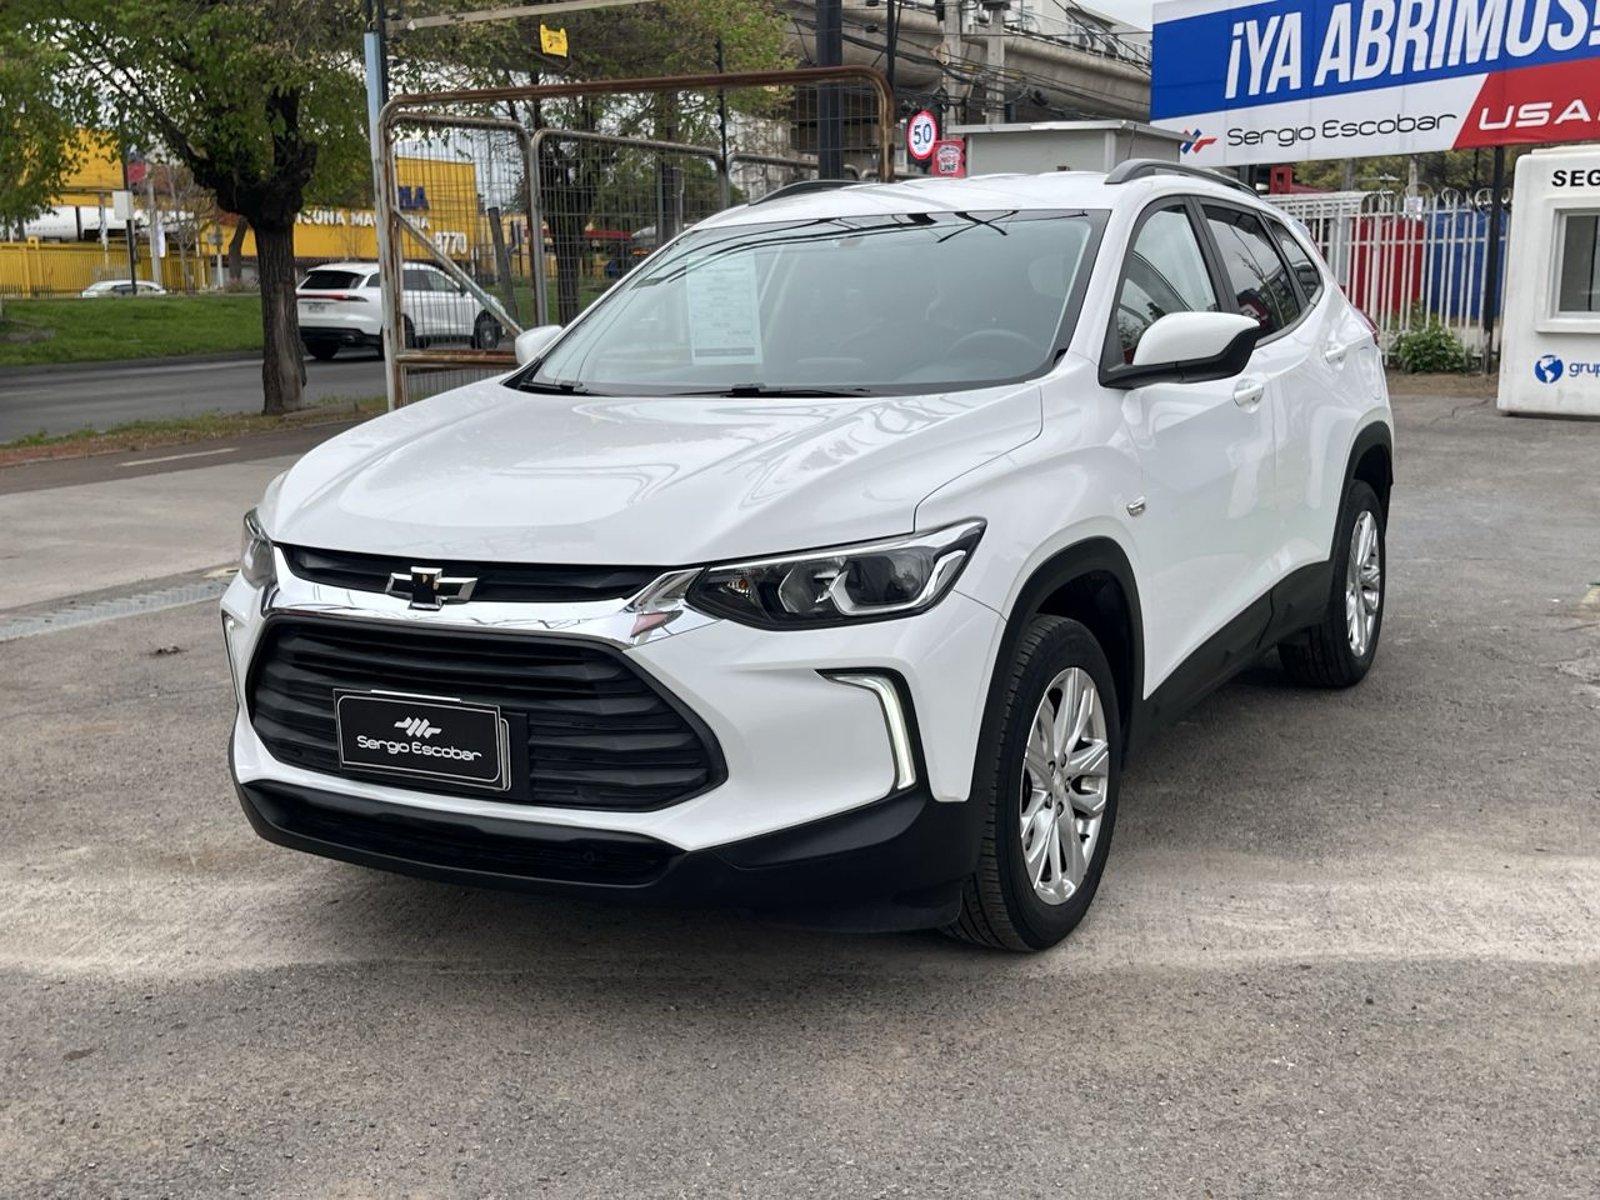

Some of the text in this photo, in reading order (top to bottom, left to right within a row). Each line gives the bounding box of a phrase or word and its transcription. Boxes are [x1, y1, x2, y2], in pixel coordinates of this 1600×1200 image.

[1225, 12, 1302, 99] ¡YA
[1226, 112, 1458, 147] Sergio Escobar
[1478, 99, 1600, 131] USA
[913, 123, 932, 146] 50
[411, 741, 482, 761] Escobar
